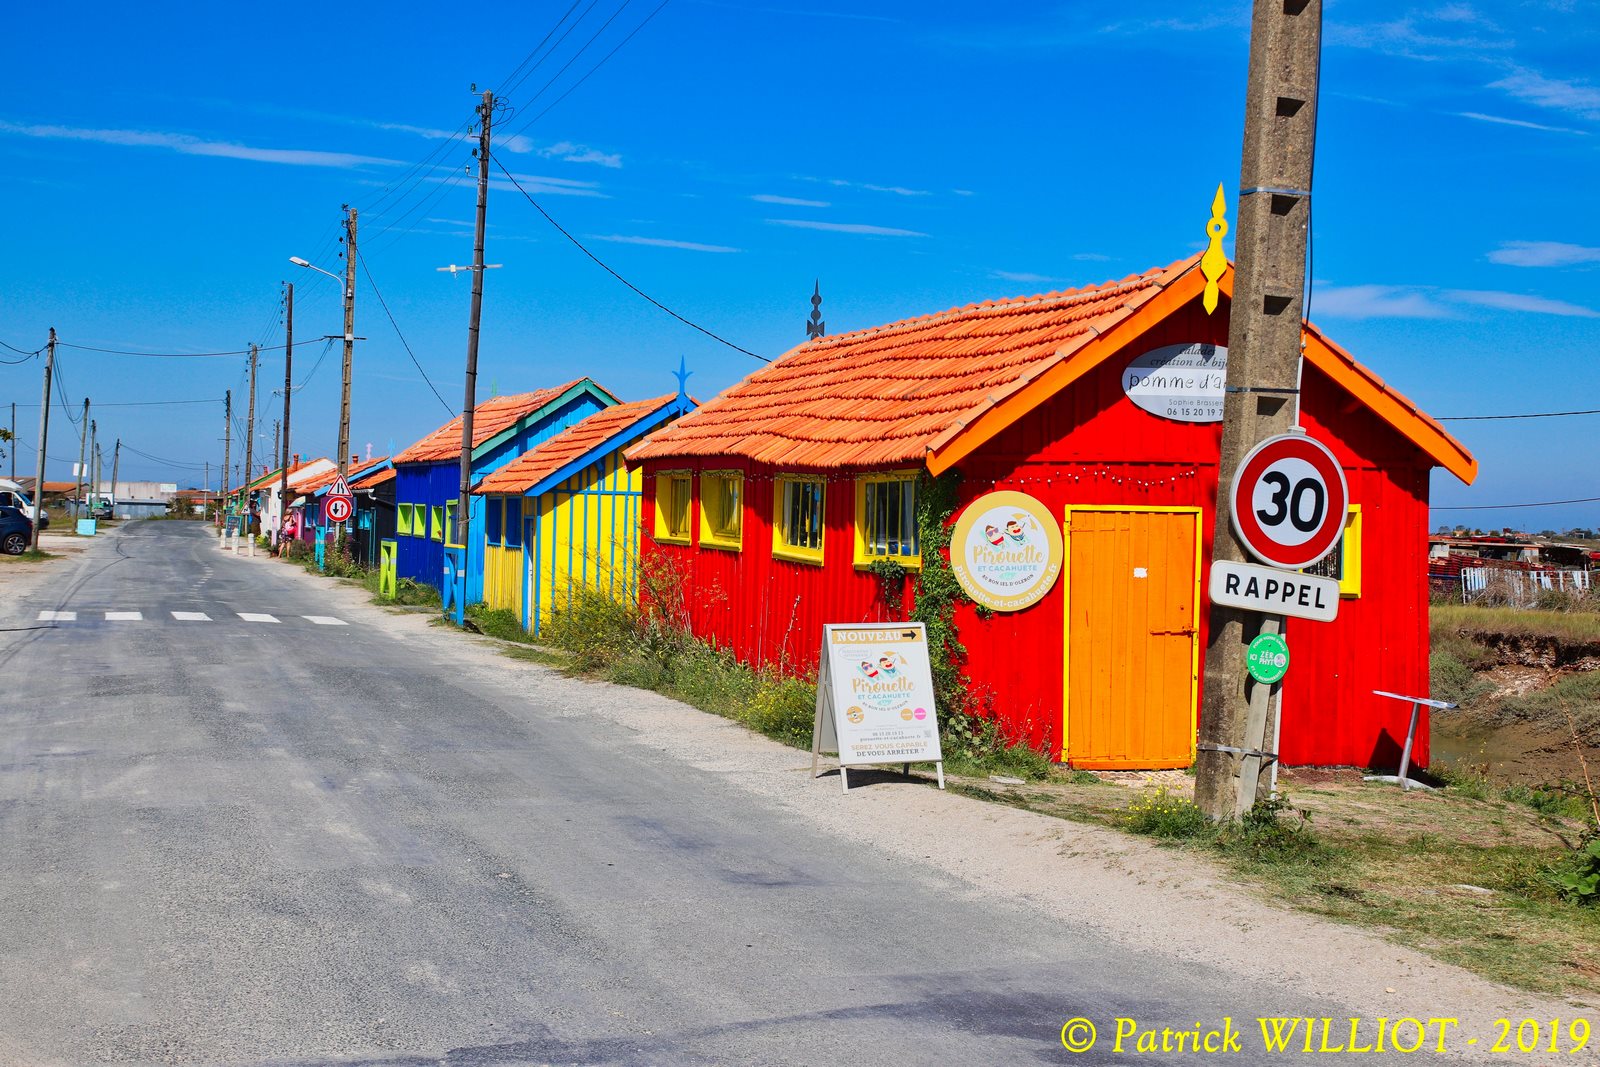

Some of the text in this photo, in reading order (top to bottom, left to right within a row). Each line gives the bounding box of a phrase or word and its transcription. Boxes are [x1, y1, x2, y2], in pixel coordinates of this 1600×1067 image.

[1196, 356, 1207, 367] de
[1211, 356, 1227, 370] bij
[1129, 373, 1194, 392] pomme
[1169, 399, 1194, 407] Sophie
[1167, 408, 1177, 416] 06
[1181, 408, 1190, 416] 15
[1193, 408, 1203, 416] 20
[1207, 408, 1216, 416] 19
[1256, 470, 1325, 533] 30
[973, 544, 1043, 564] Pirouette
[1225, 573, 1326, 610] RAPPEL
[837, 631, 901, 642] NOUVEAU
[852, 676, 914, 693] Pirouette
[851, 741, 928, 751] SEREZ VOUS CAPABLE
